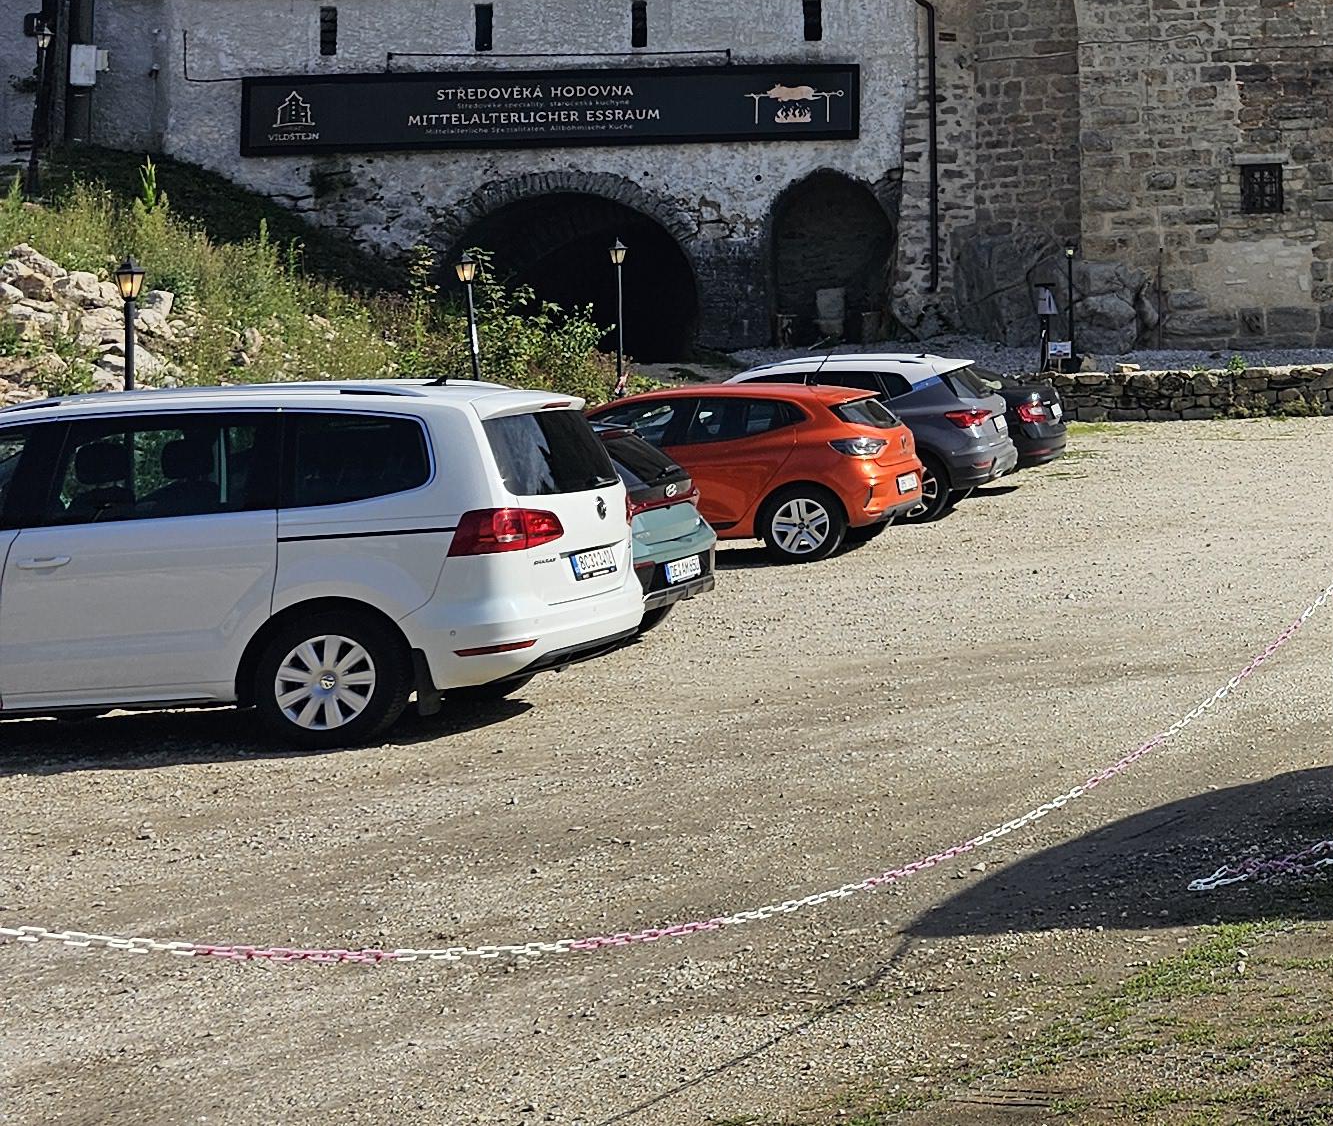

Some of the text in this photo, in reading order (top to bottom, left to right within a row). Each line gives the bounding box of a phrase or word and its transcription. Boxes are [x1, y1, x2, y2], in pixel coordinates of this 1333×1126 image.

[550, 85, 634, 97] HODOVNA
[407, 109, 661, 126] MITTELALTERLICHER ESSRAUM
